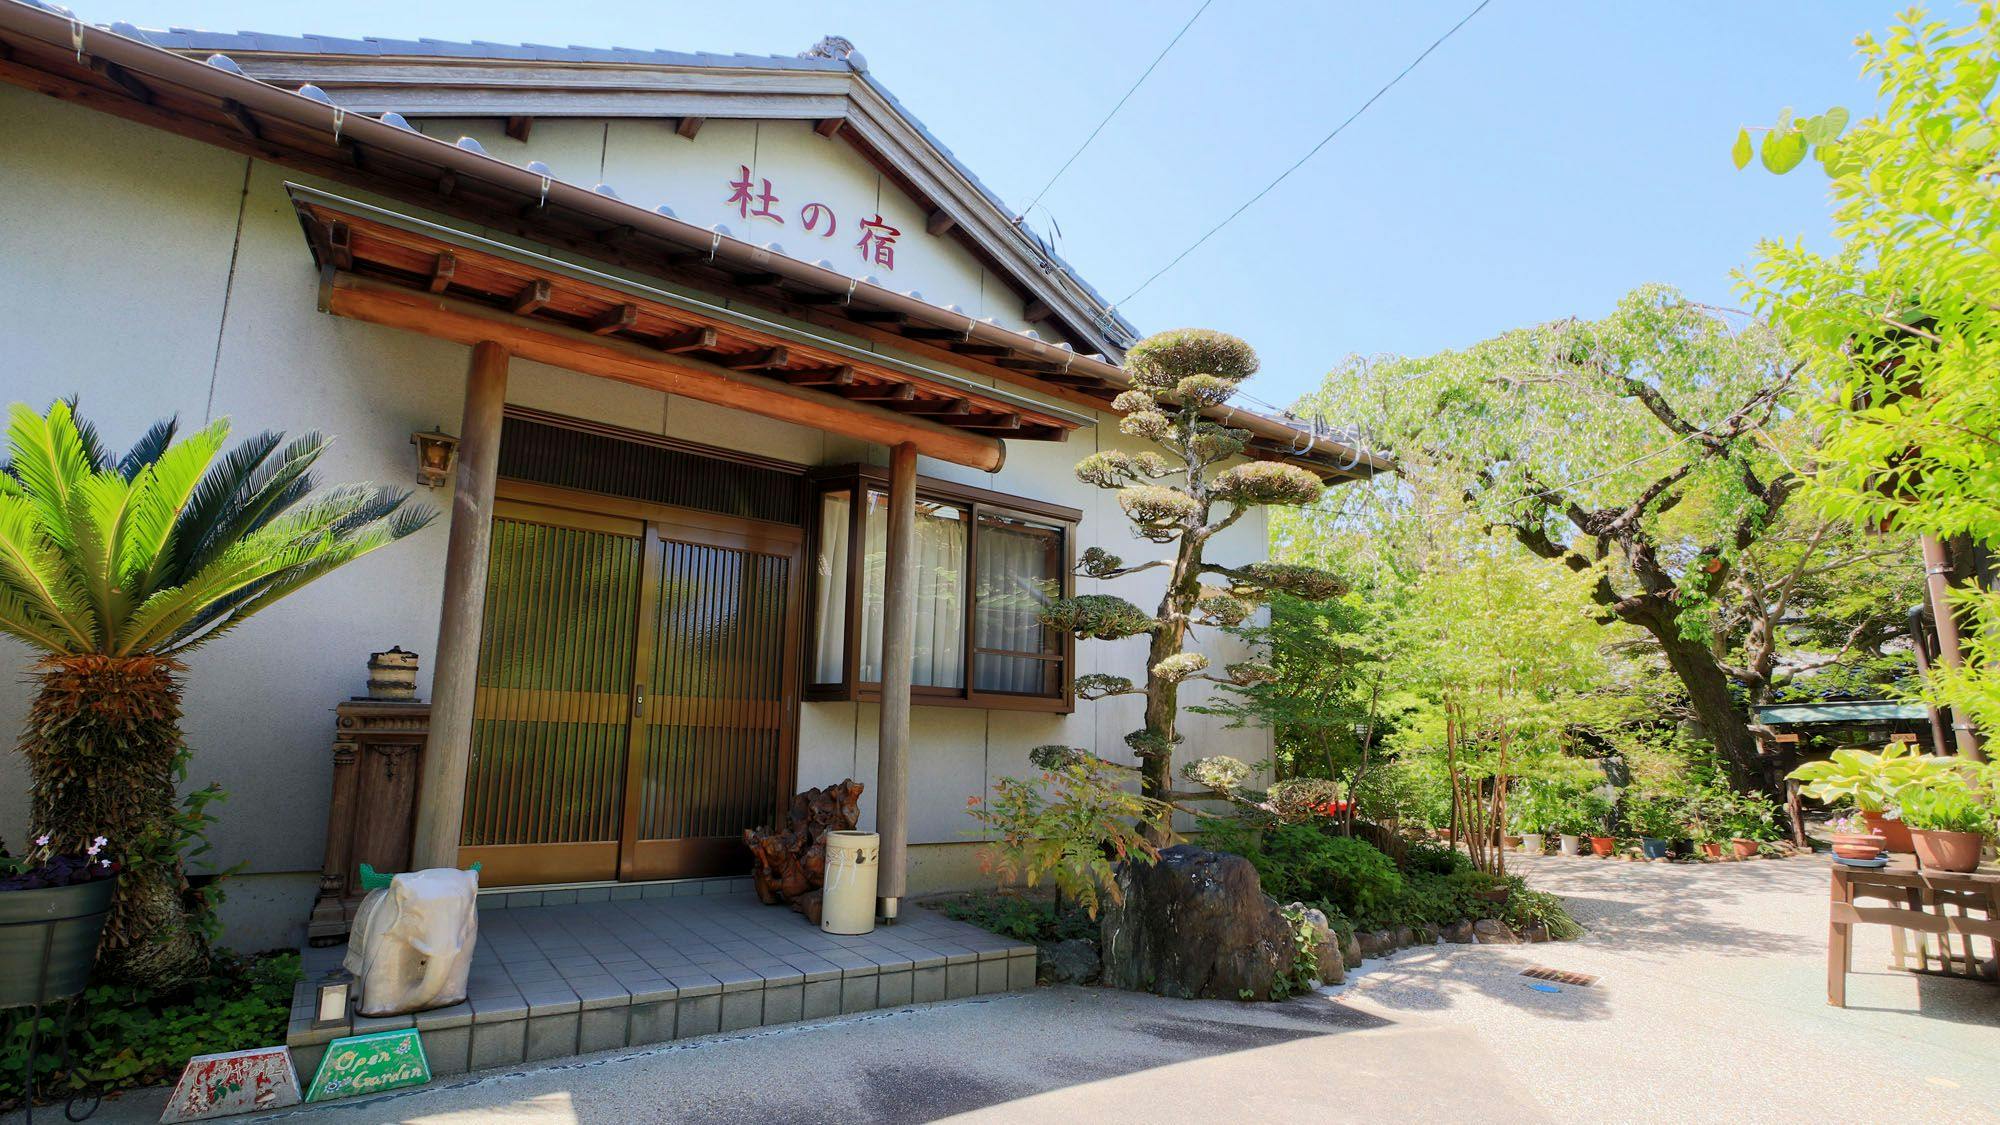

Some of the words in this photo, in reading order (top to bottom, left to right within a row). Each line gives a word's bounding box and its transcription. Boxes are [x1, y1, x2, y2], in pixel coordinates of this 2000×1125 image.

[727, 165, 901, 271] 杜の宿
[333, 1050, 391, 1073] Open
[351, 1064, 423, 1089] Garden
